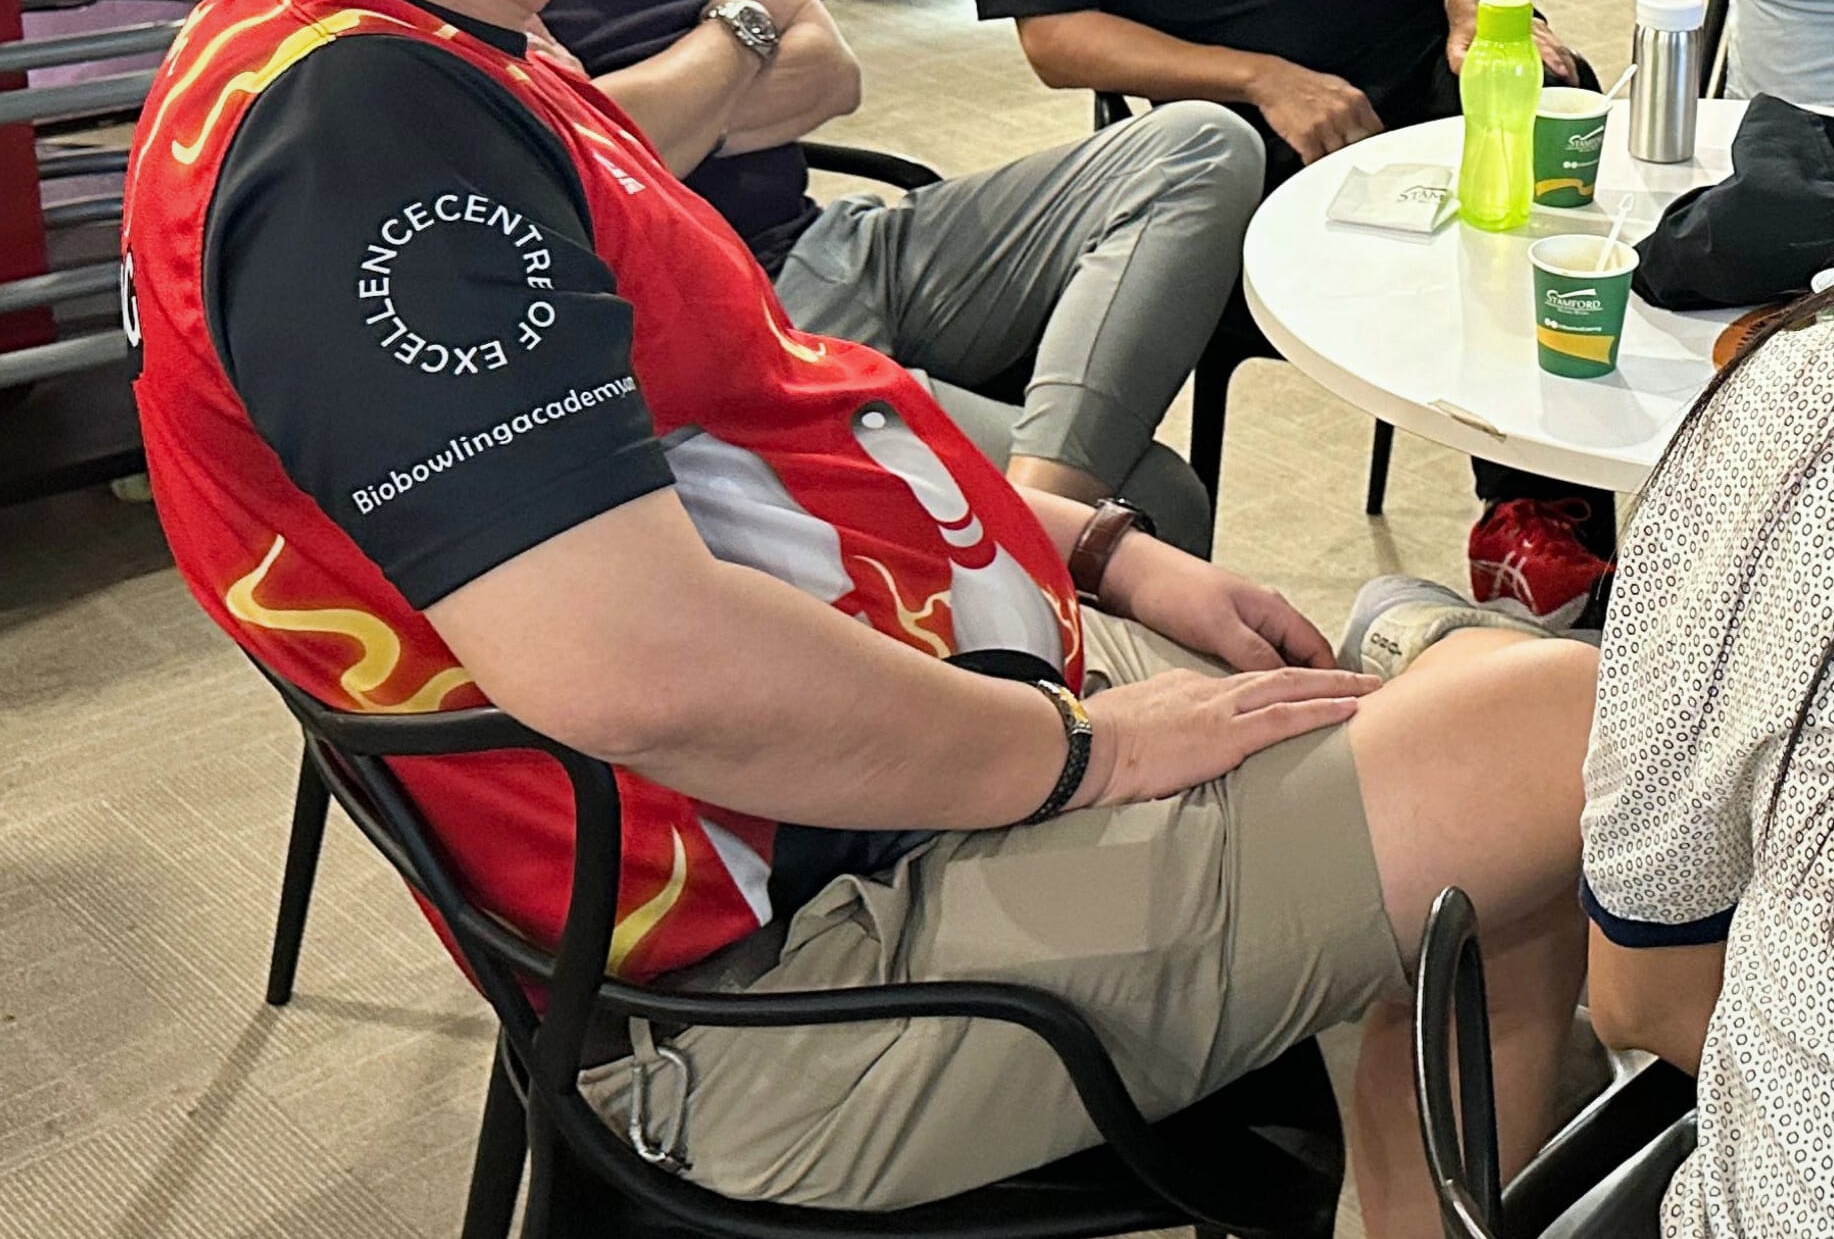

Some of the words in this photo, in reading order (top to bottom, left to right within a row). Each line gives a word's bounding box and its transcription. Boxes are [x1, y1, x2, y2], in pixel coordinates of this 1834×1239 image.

[359, 202, 509, 375] EXCELLENCE
[434, 194, 553, 290] CENTRE
[121, 251, 142, 348] G
[518, 301, 555, 350] OF
[1546, 290, 1601, 309] STAMFORD
